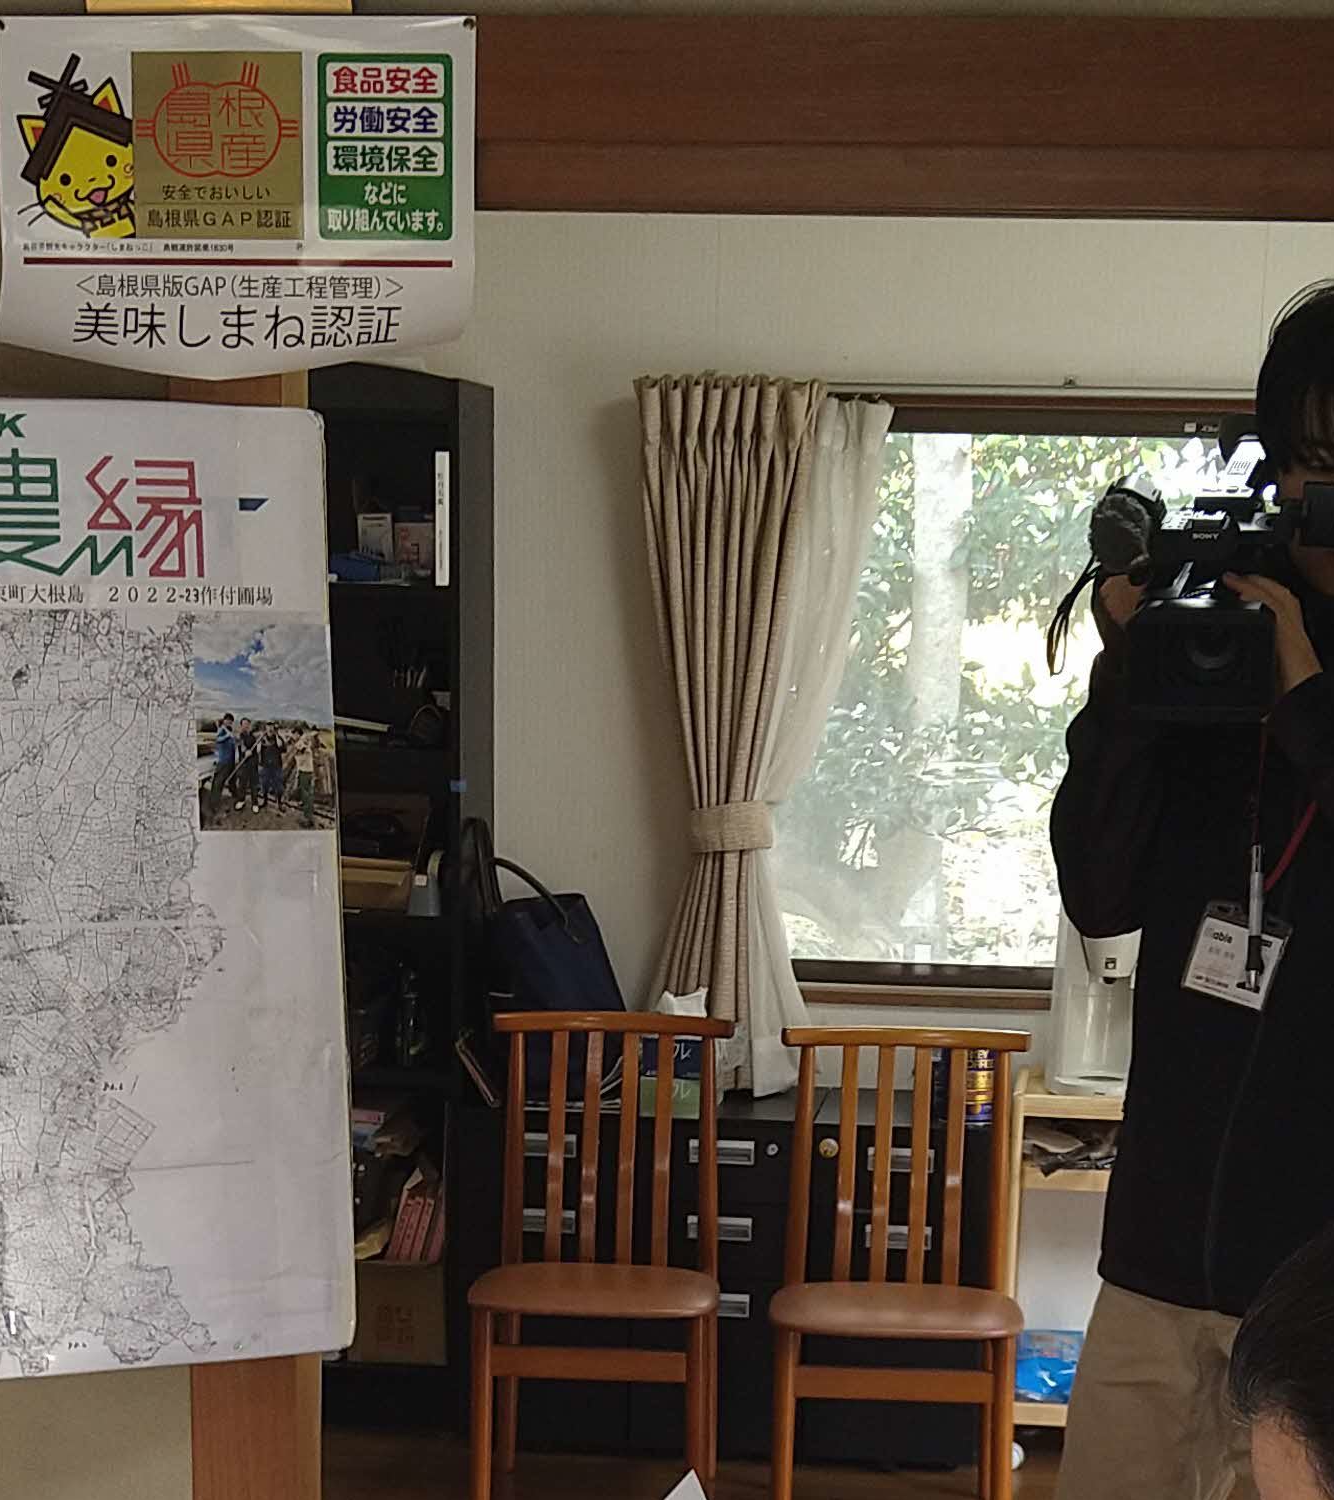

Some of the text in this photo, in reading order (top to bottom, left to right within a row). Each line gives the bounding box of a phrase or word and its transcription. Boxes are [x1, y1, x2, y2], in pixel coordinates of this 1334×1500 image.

[332, 66, 439, 95] 食品安全
[333, 105, 439, 134] 労働安全
[333, 145, 439, 173] 環境保全
[162, 184, 271, 201] 安全でおいしい
[363, 182, 407, 204] などに
[327, 209, 446, 234] 取り組んでいます。
[73, 302, 403, 349] 美味しまね認証
[1192, 533, 1219, 541] SONY
